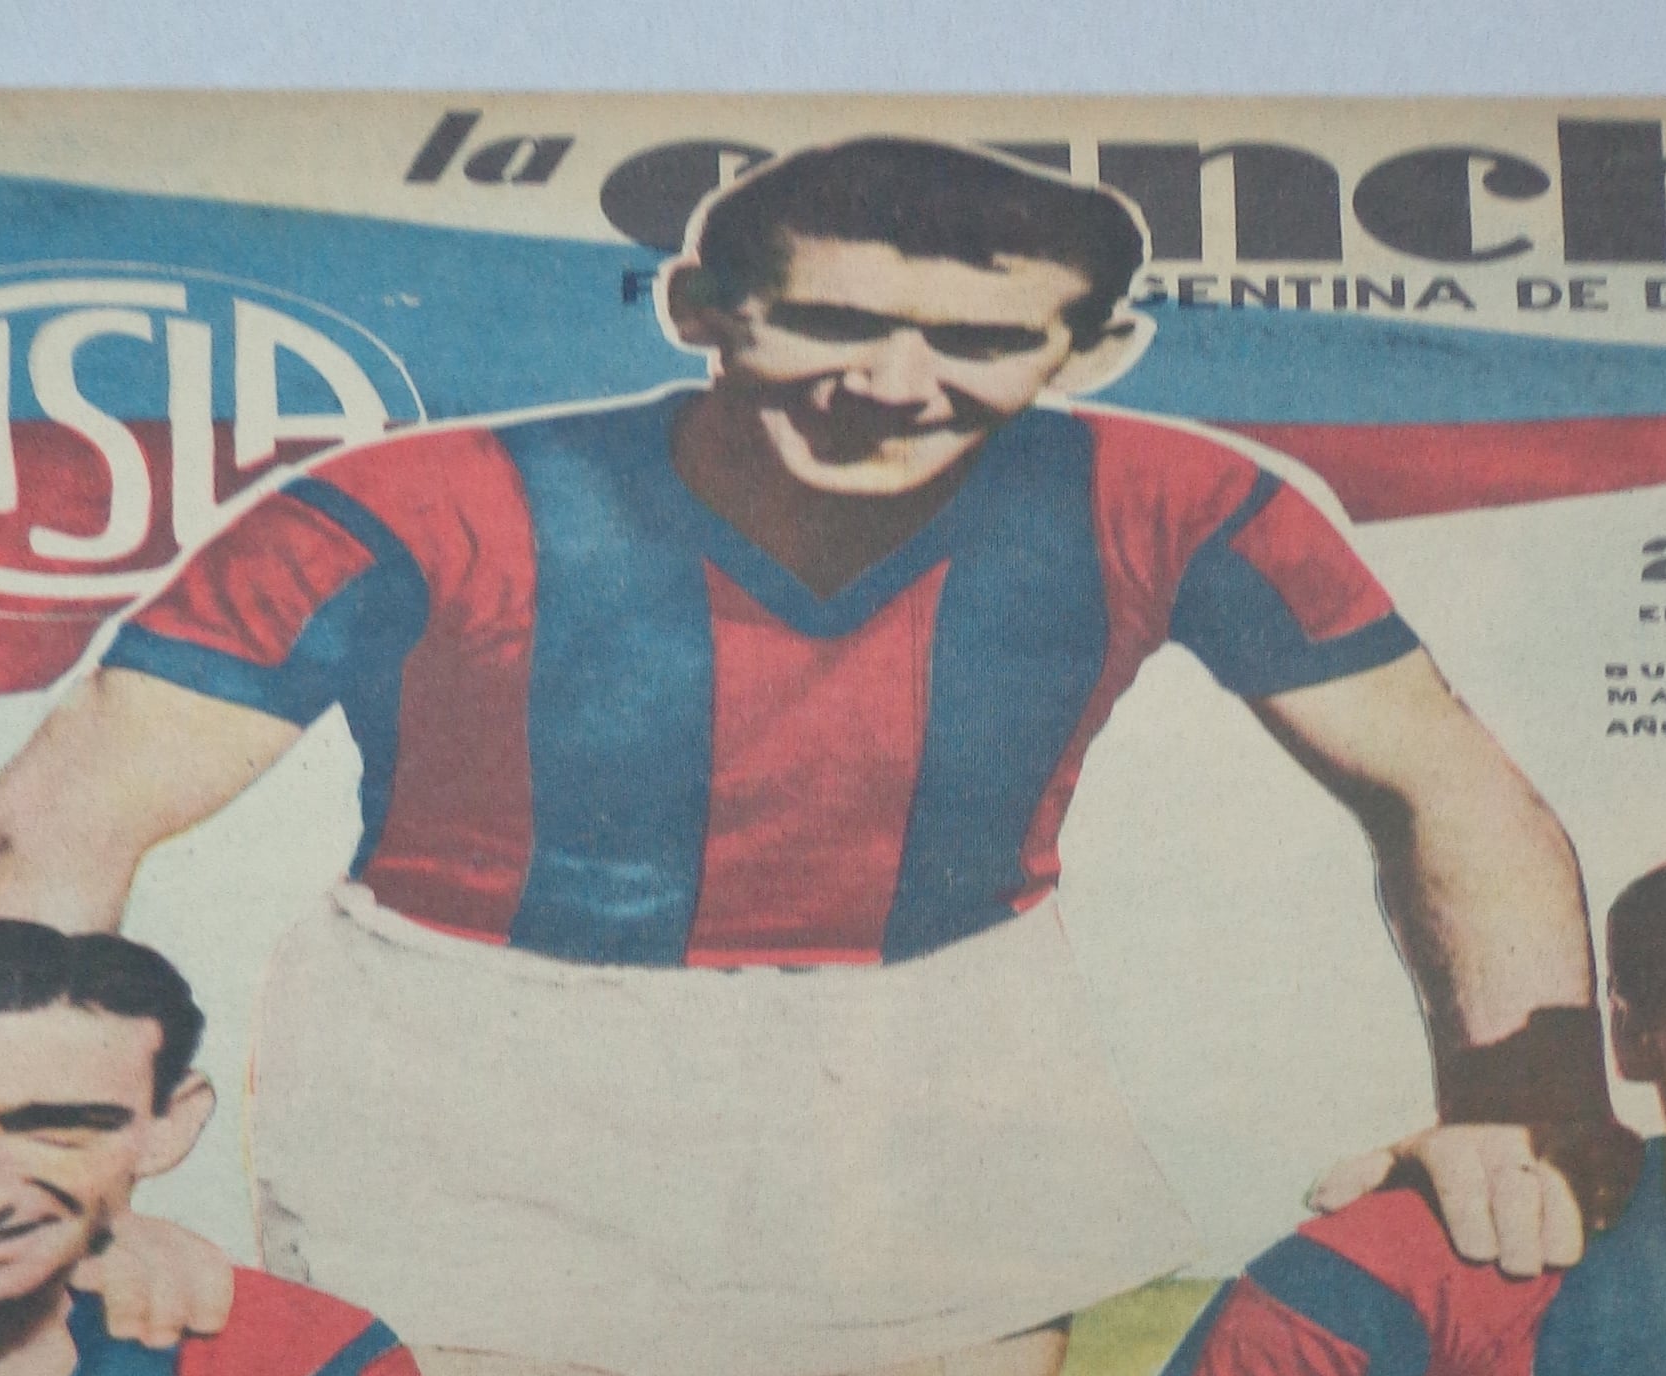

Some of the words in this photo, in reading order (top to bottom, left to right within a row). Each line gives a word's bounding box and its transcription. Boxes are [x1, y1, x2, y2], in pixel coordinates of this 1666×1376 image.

[405, 109, 575, 185] la
[1129, 275, 1479, 315] GENTINA
[1516, 277, 1609, 313] DE
